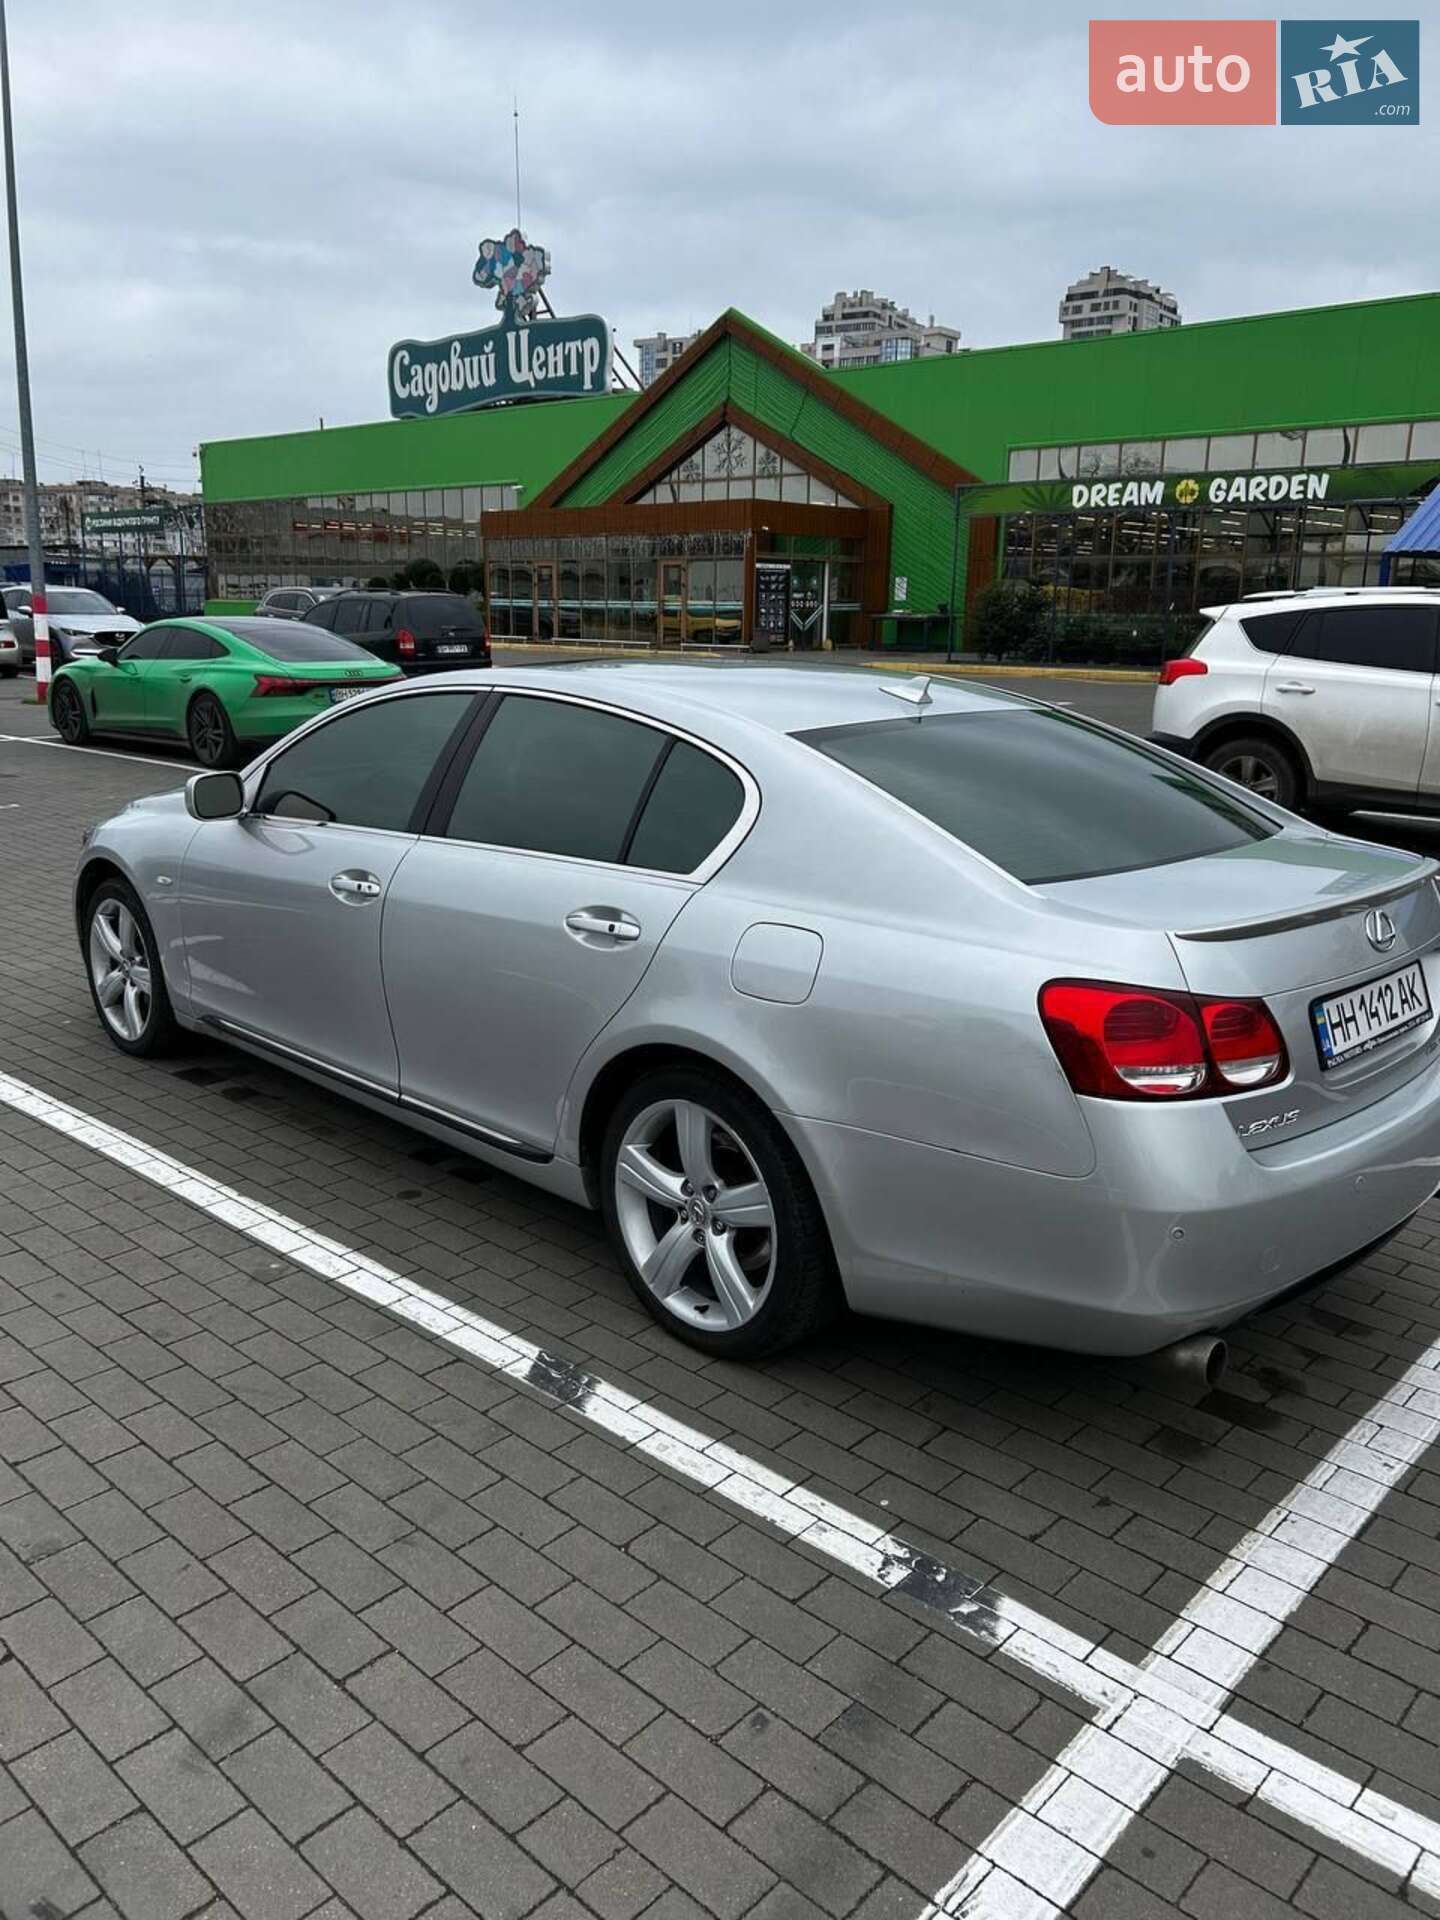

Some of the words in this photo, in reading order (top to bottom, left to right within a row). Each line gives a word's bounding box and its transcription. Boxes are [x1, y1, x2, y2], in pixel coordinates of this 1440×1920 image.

[393, 340, 496, 413] Садовий
[506, 328, 600, 390] Центр
[1072, 479, 1165, 508] DREAM
[1208, 473, 1330, 503] GARDEN
[1239, 1109, 1300, 1136] LEXUS
